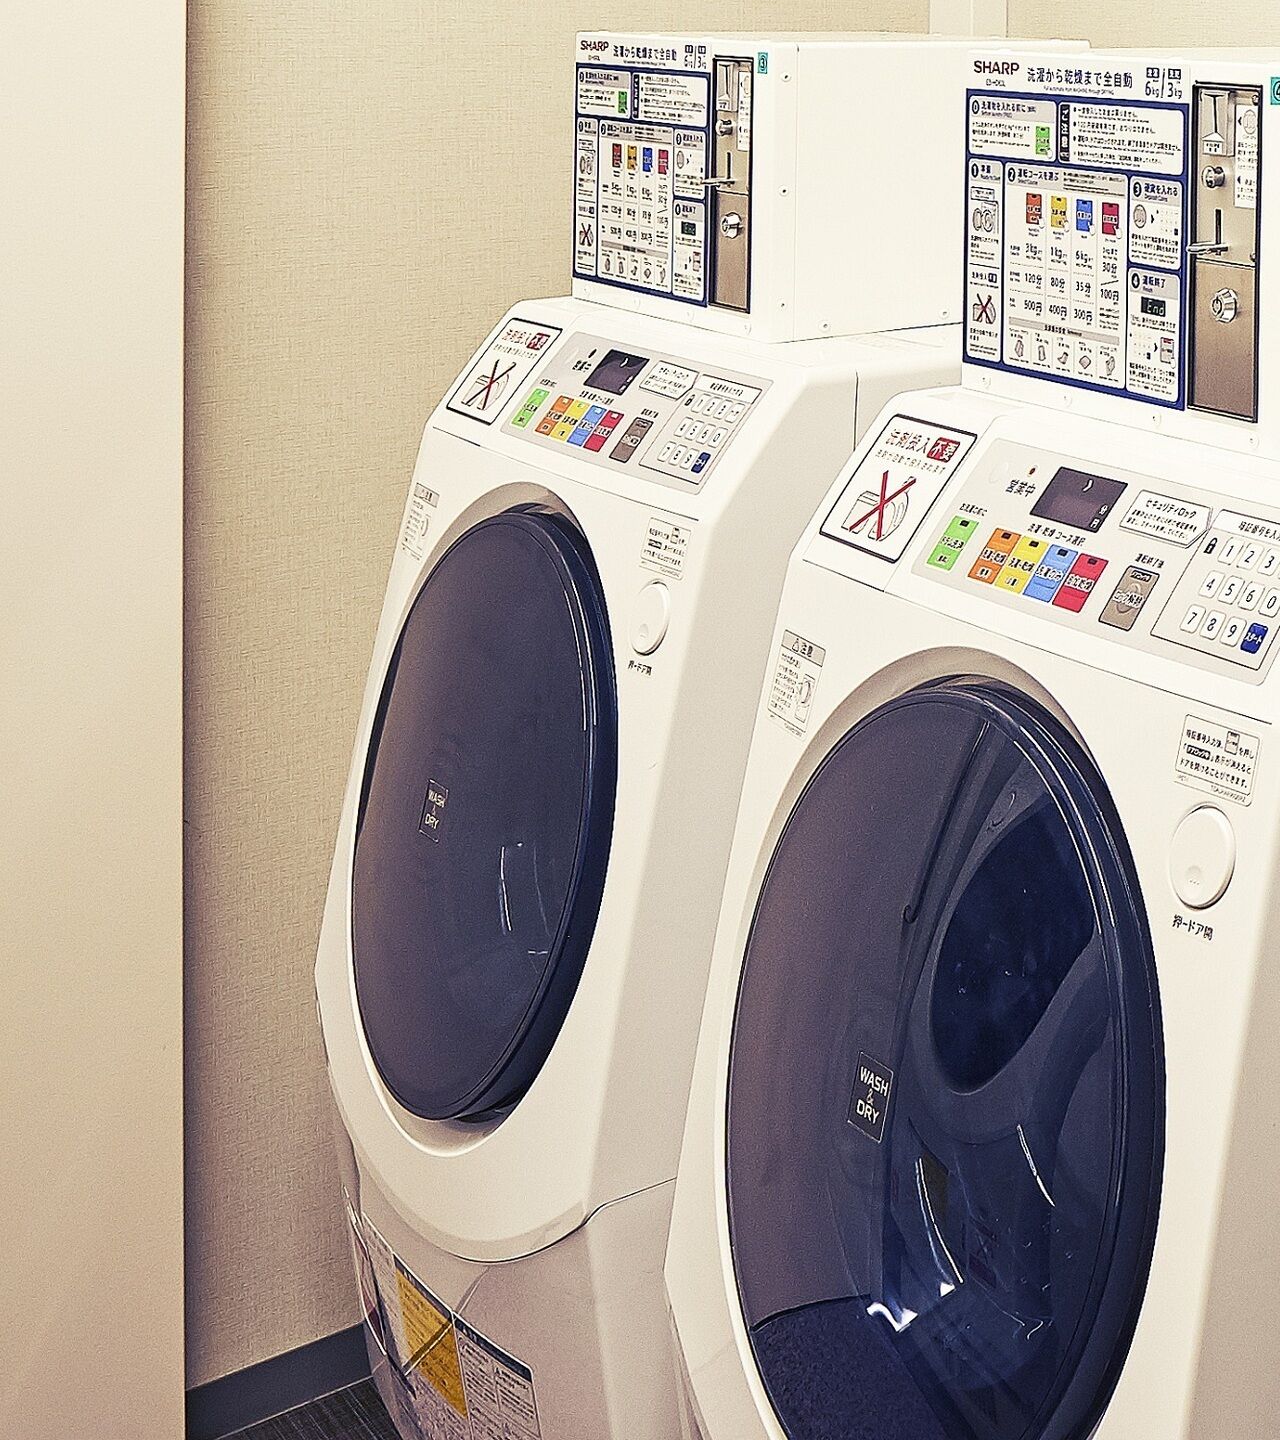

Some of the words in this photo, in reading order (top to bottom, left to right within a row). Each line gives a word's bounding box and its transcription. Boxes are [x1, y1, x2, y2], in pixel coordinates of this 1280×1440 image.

[580, 40, 609, 52] SHARP
[974, 60, 1020, 75] SHARP
[1226, 545, 1234, 558] 1
[1244, 550, 1255, 564] 2
[1225, 583, 1236, 597] 5
[1207, 617, 1217, 632] 8
[1229, 624, 1238, 638] 9
[860, 1066, 889, 1097] WASH
[856, 1099, 880, 1124] DRY
